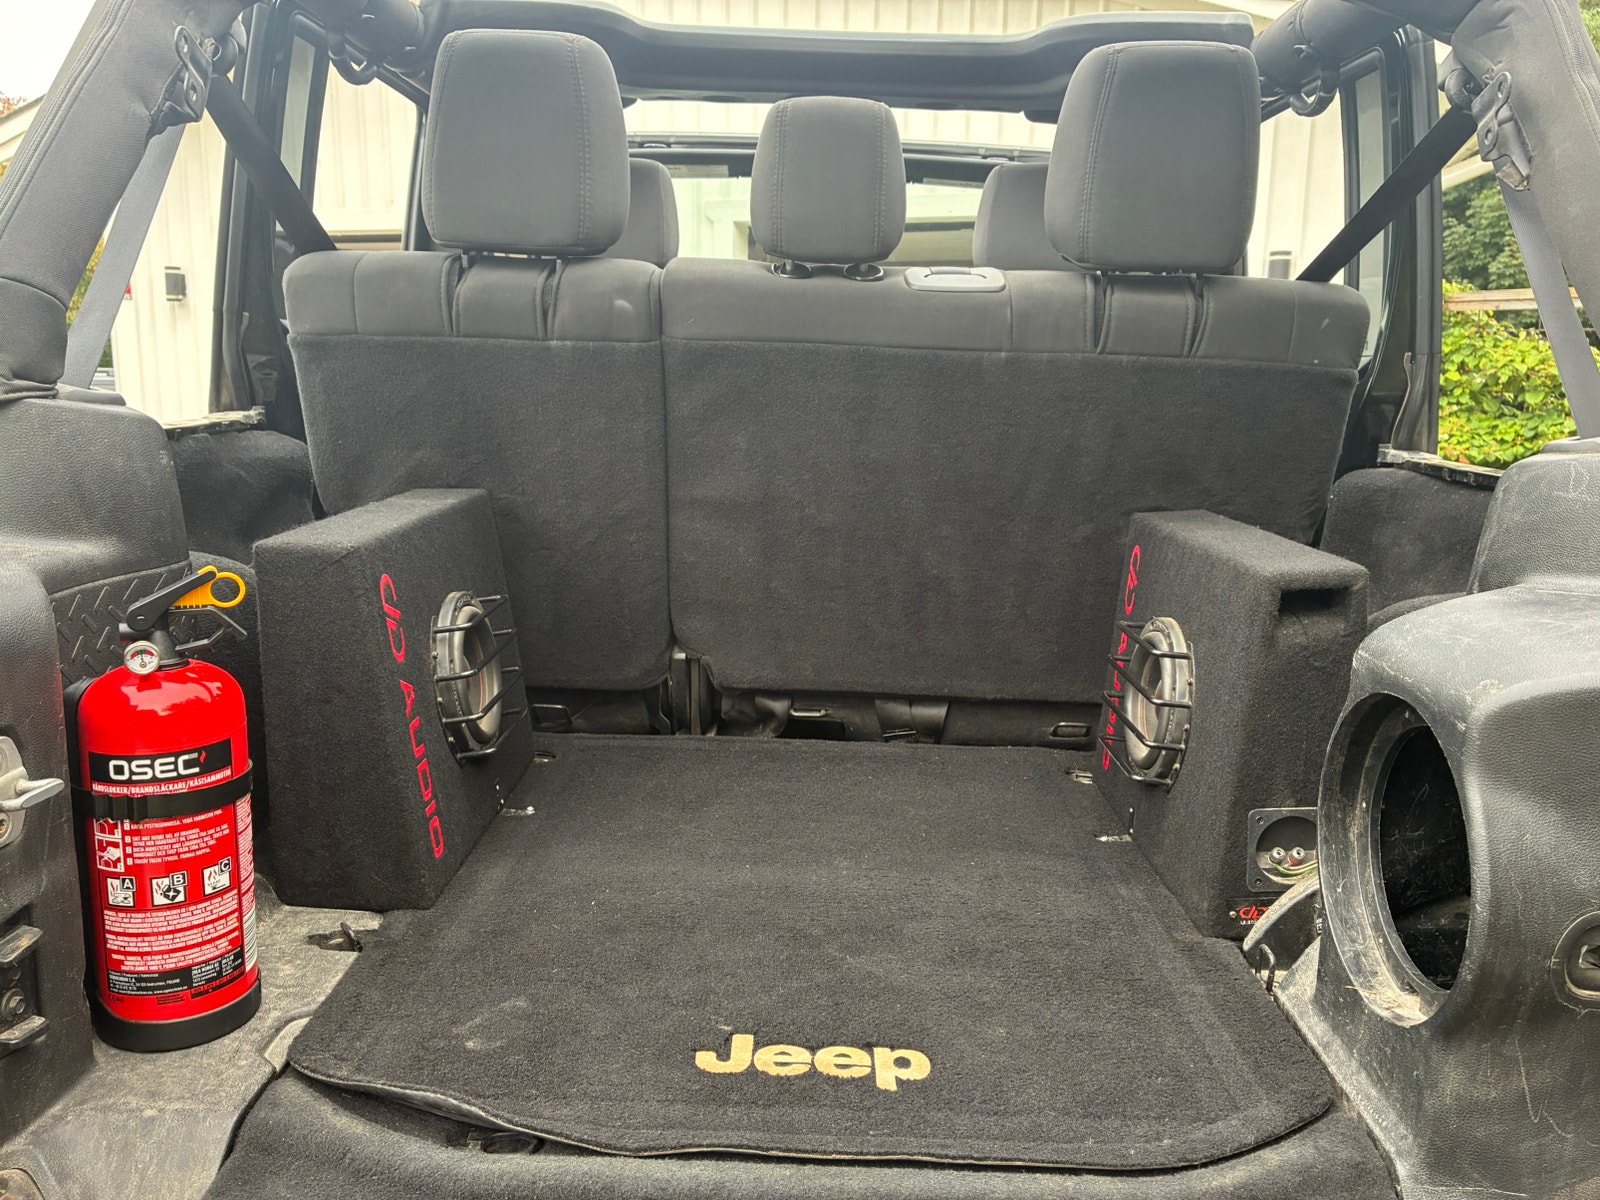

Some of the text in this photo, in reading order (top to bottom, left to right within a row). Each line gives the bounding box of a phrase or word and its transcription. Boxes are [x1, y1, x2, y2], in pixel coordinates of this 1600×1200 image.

[109, 752, 200, 781] OSEC
[400, 679, 445, 860] AUDIO
[221, 861, 230, 871] C
[123, 880, 133, 889] A
[174, 876, 184, 885] B
[695, 1033, 931, 1091] Jeep
